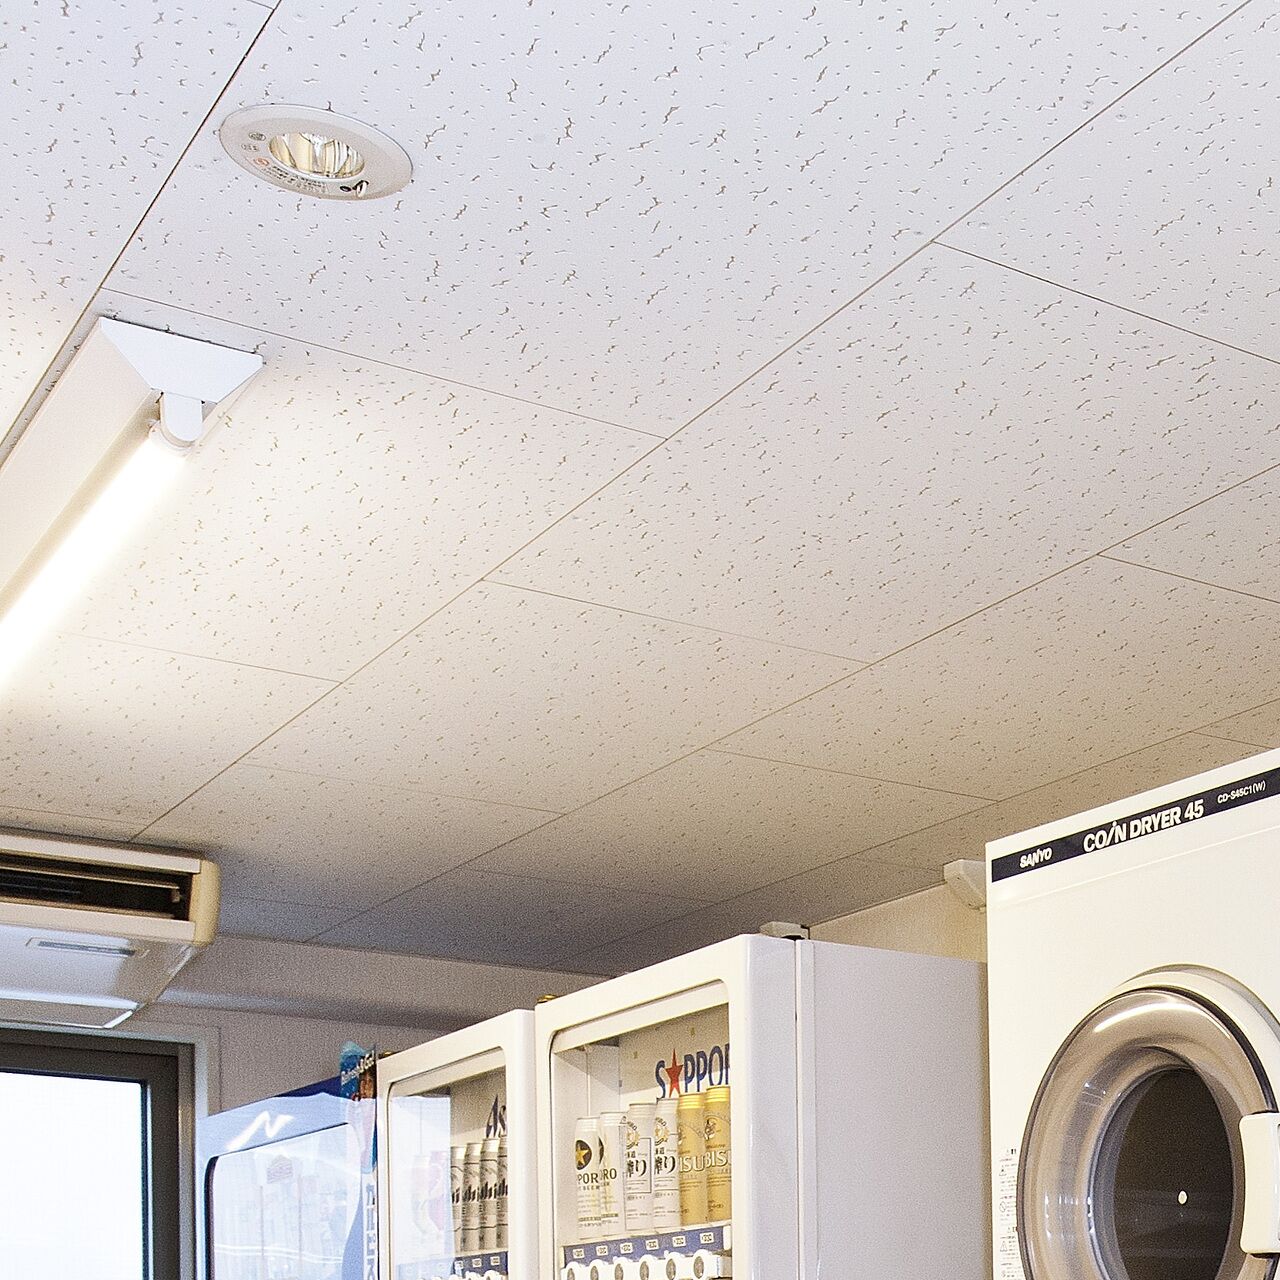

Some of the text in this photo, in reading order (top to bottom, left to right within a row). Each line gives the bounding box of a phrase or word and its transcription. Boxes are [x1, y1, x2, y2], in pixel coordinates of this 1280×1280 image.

[1129, 807, 1181, 840] DRYER
[1183, 799, 1204, 821] 45
[1019, 847, 1052, 868] SANYO
